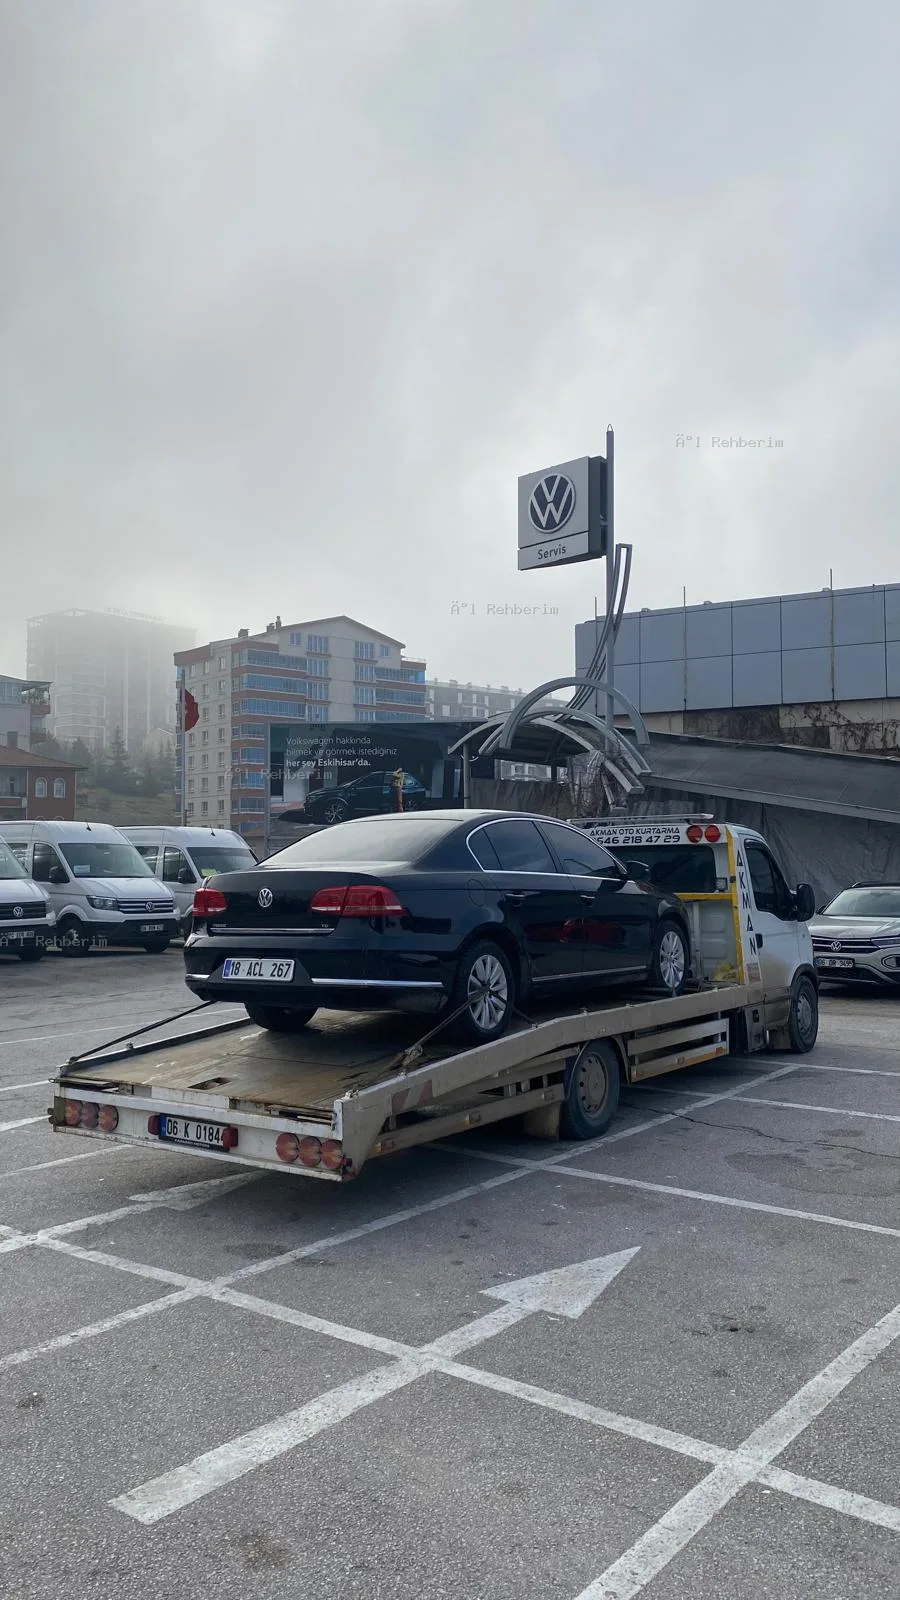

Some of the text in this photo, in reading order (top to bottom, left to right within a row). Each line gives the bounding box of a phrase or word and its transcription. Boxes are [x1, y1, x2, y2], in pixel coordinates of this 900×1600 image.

[537, 544, 567, 560] Servis
[286, 736, 333, 747] Volkswagen
[286, 759, 300, 767] her
[590, 828, 618, 837] AKMAN
[636, 827, 680, 835] KURTARMA
[622, 835, 642, 844] 218
[645, 835, 660, 843] 47
[663, 834, 681, 843] 29
[736, 849, 757, 955] AKMAN
[230, 961, 292, 978] 18 ACL 267
[167, 1118, 178, 1136] 06
[184, 1122, 190, 1139] K
